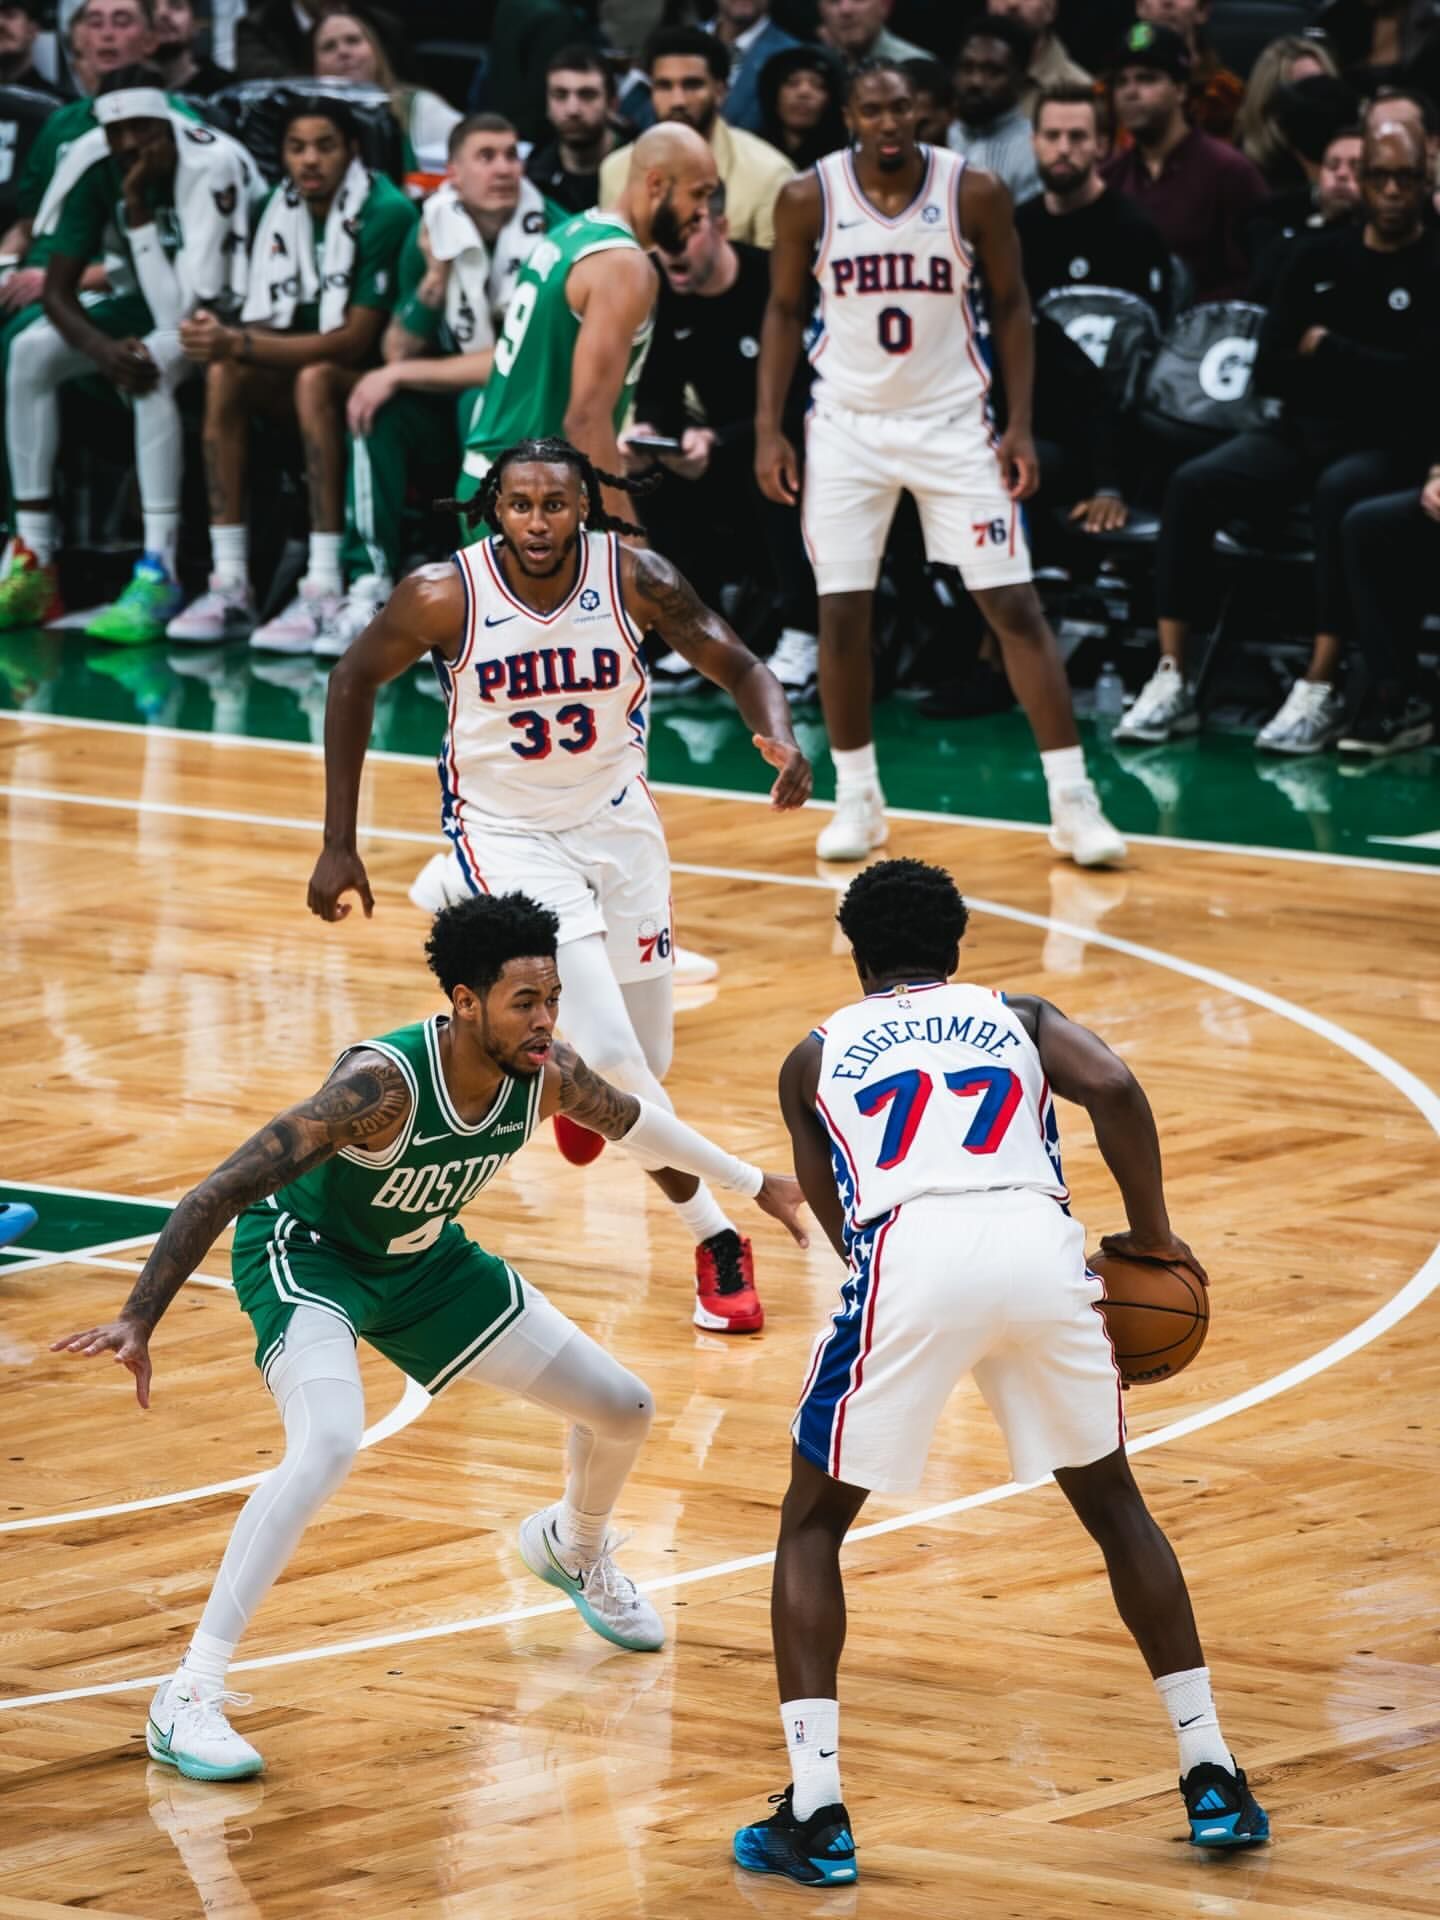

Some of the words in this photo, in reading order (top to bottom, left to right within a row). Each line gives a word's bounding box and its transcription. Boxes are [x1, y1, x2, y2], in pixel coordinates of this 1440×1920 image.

[830, 252, 954, 297] PHILA
[878, 306, 914, 355] 0
[971, 516, 1007, 548] 76
[475, 647, 621, 703] PHILA
[508, 702, 598, 761] 33
[638, 927, 671, 964] 76
[832, 1015, 1021, 1081] EDGECOMBE
[490, 1120, 525, 1138] Amica
[853, 1065, 1024, 1171] 77
